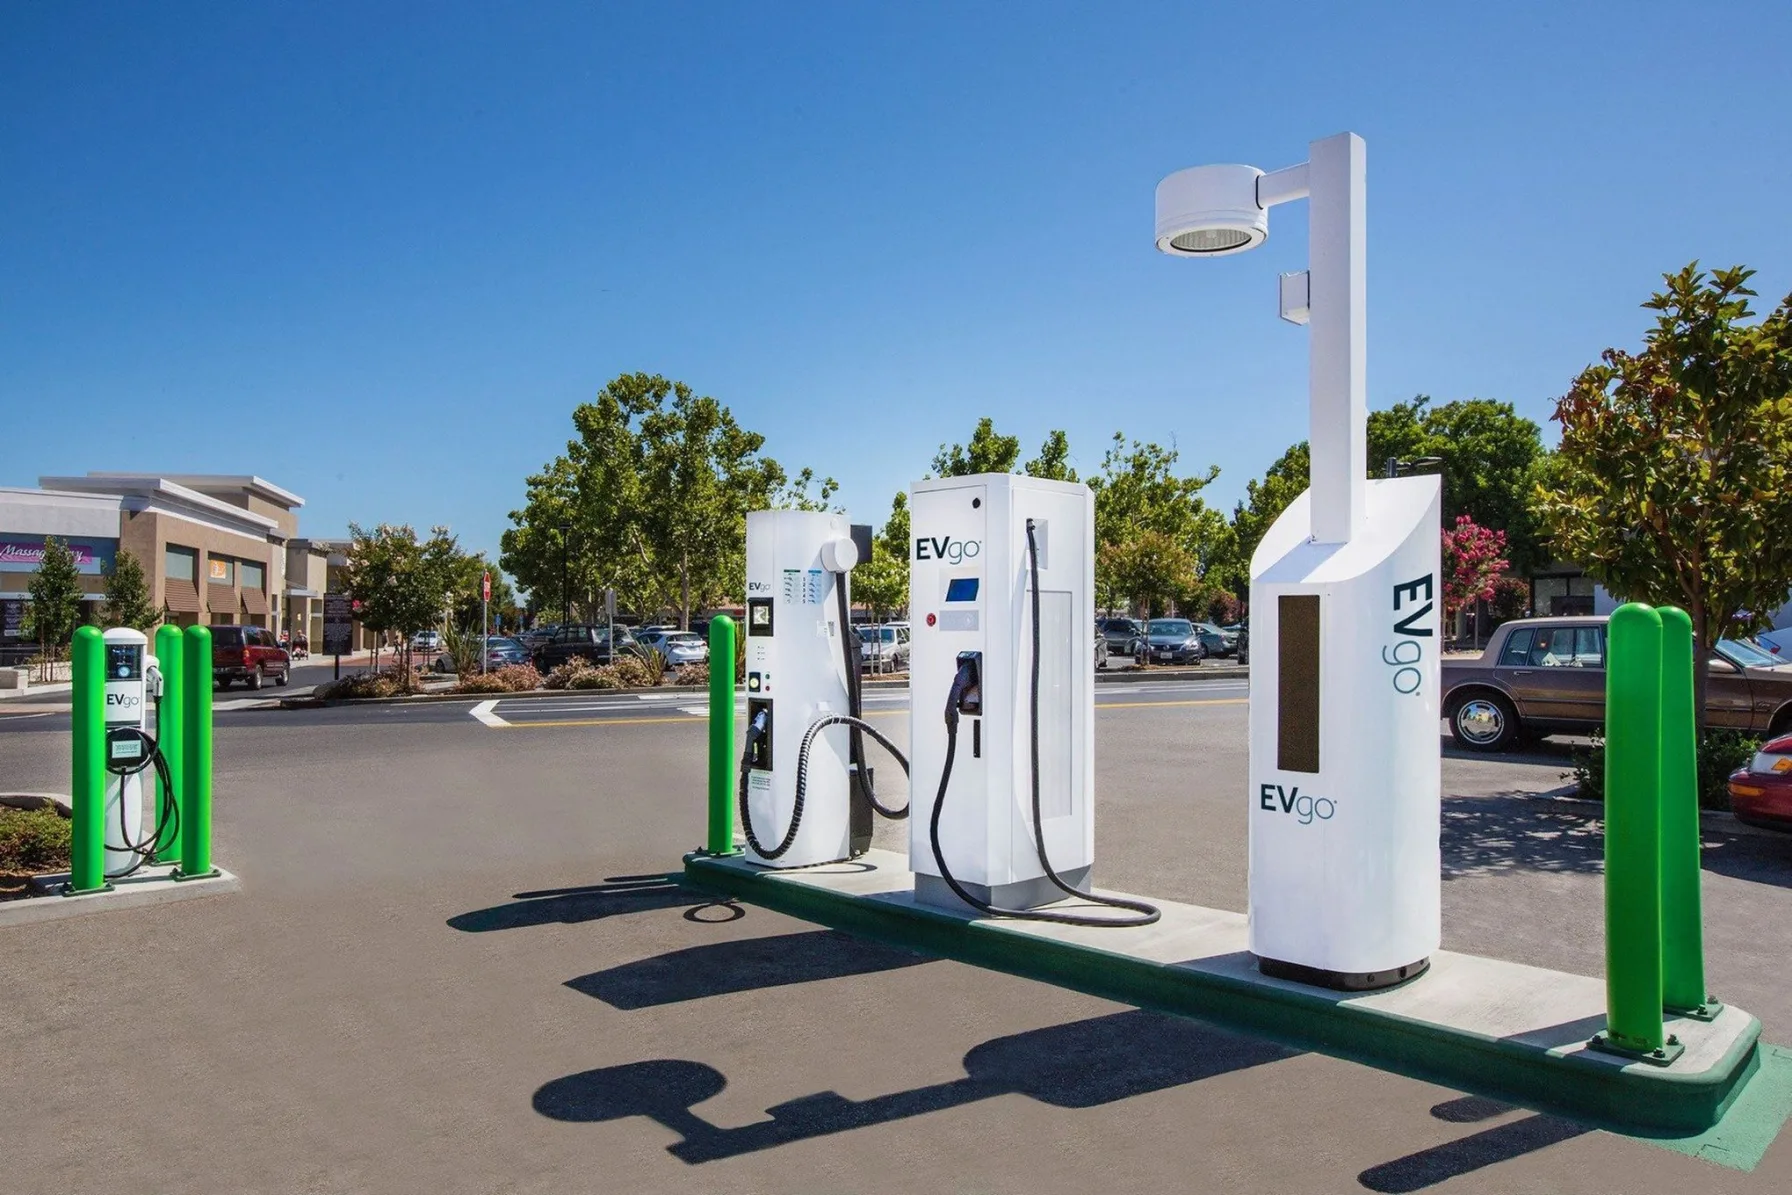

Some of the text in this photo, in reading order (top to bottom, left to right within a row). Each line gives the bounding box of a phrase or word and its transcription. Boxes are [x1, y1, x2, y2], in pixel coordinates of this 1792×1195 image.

[0, 545, 46, 560] Massag
[916, 536, 980, 565] EVgo
[749, 582, 770, 592] EVgo
[1382, 573, 1433, 695] EVgo
[107, 694, 139, 708] EVgo
[1261, 784, 1336, 825] EVgo
